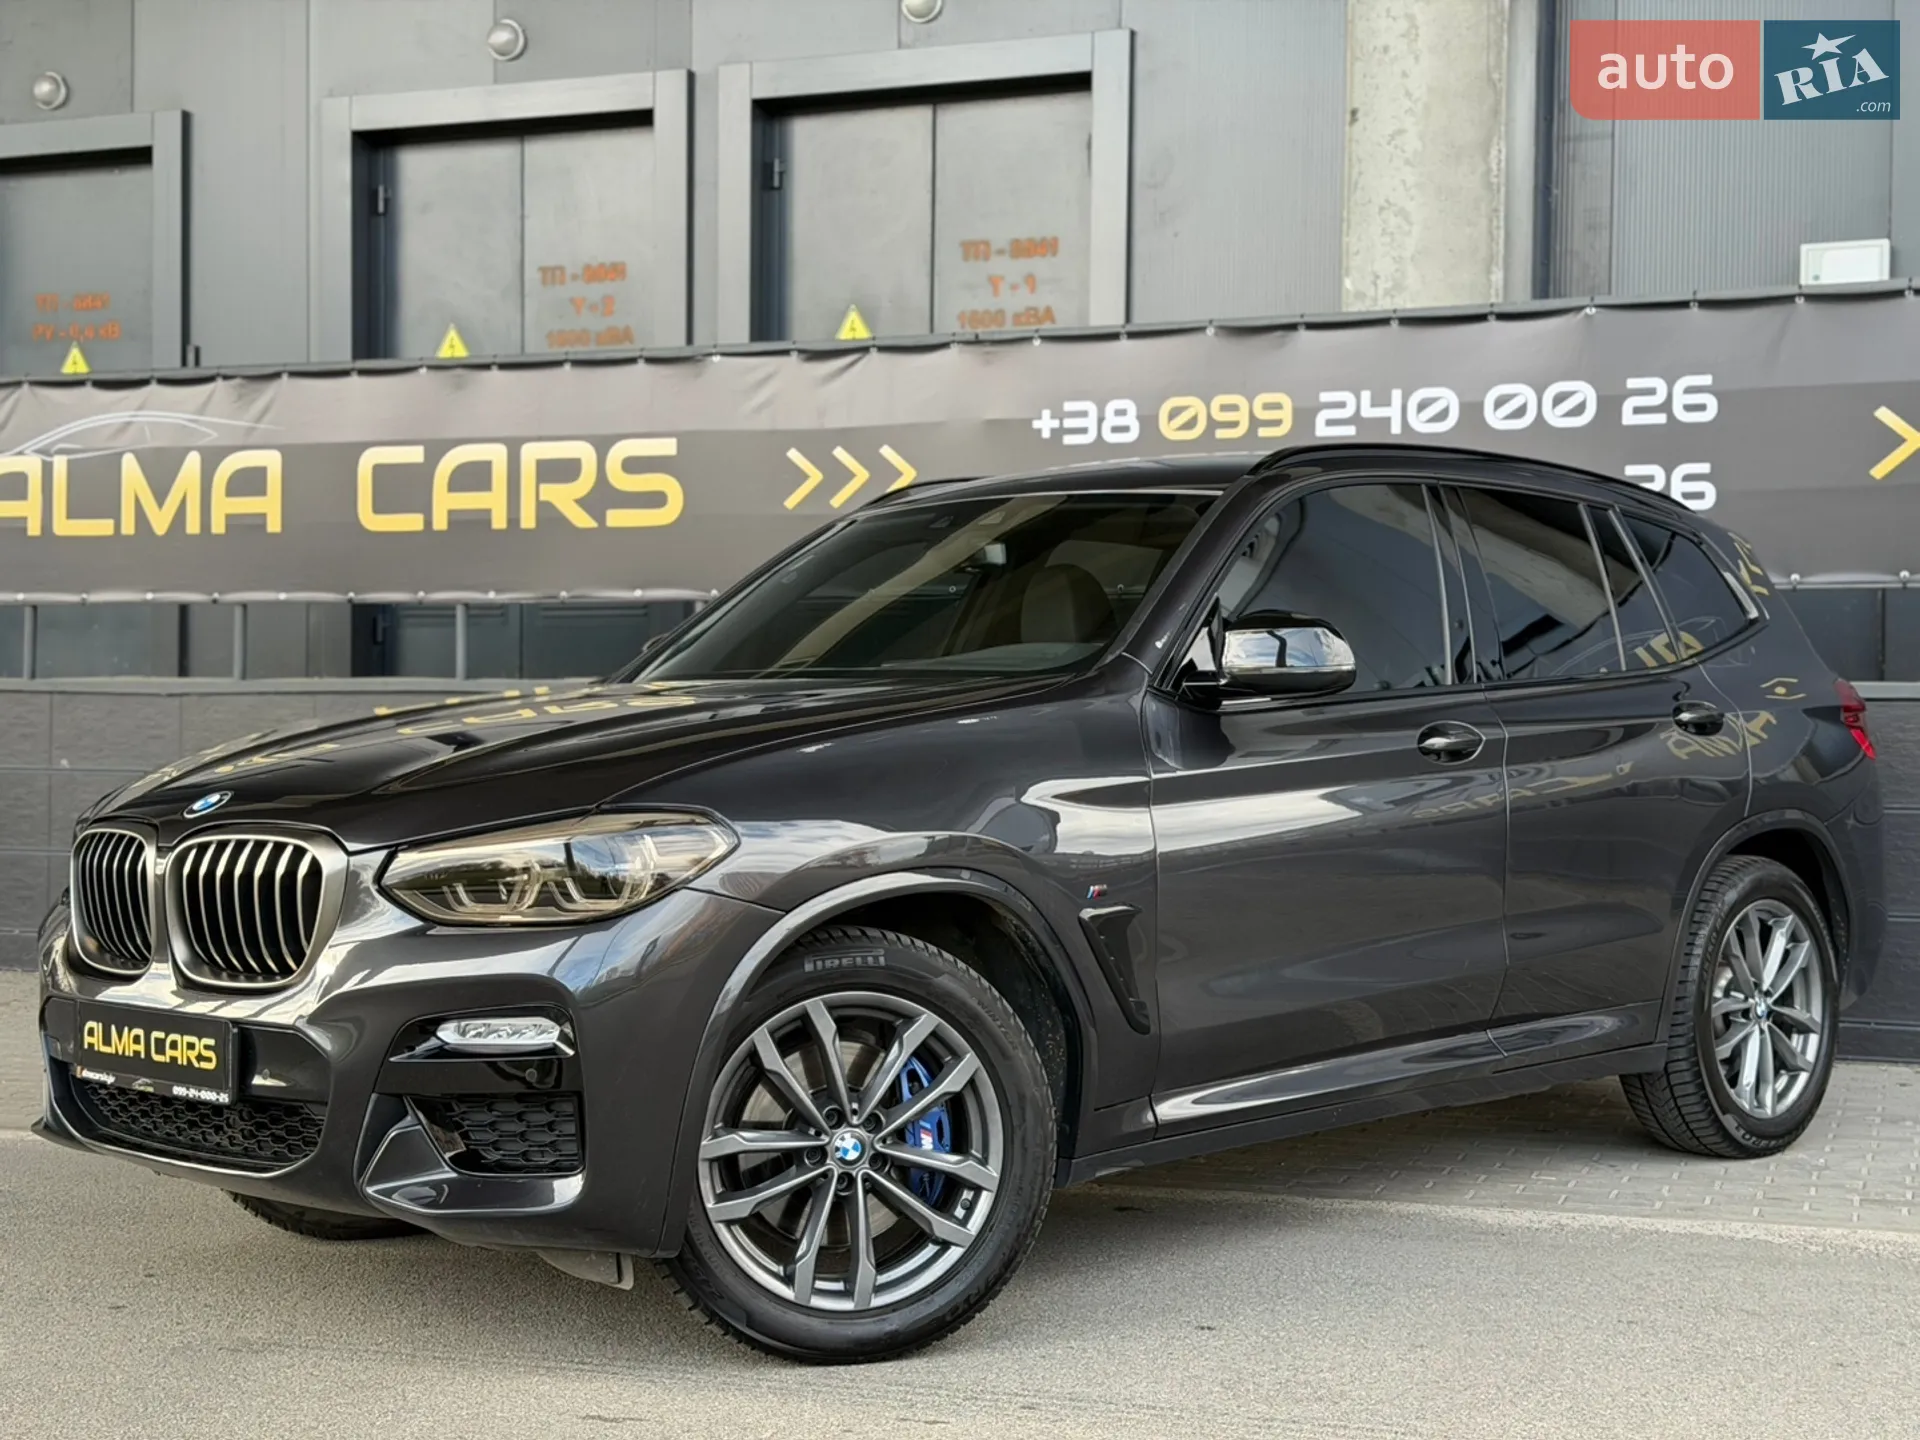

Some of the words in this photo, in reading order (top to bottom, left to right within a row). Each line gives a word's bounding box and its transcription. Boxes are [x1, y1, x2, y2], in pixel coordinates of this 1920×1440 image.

[1032, 398, 1140, 445] +38
[1158, 392, 1293, 441] 099
[1314, 386, 1460, 437] 240
[1483, 380, 1598, 431] 00
[1621, 373, 1719, 425] 26
[0, 448, 283, 537] ALMA
[356, 437, 684, 532] CARS
[803, 948, 886, 973] PIRELLI
[83, 1020, 146, 1060] ALMA
[150, 1030, 218, 1071] CARS
